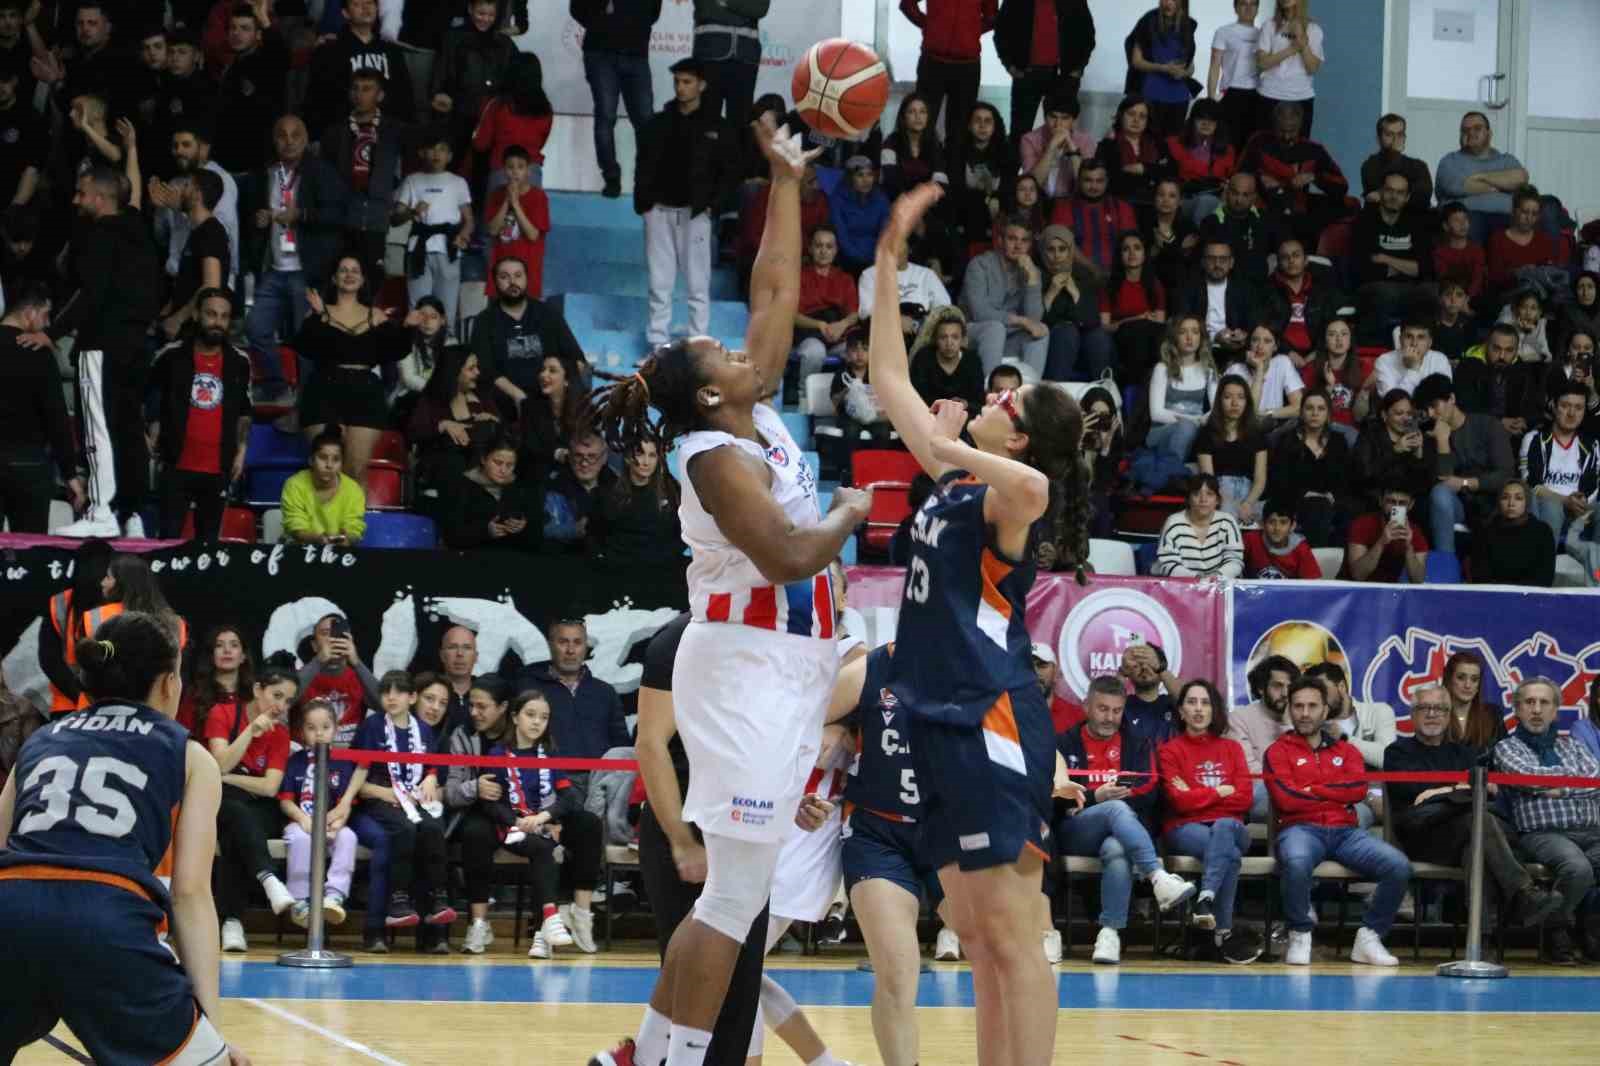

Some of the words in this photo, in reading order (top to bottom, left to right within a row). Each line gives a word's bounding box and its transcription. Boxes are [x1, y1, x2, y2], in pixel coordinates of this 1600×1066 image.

[250, 544, 285, 576] of
[301, 544, 357, 567] the
[906, 555, 930, 604] 13
[17, 754, 149, 839] 35
[731, 796, 774, 809] ECOLAB
[899, 768, 921, 805] 5
